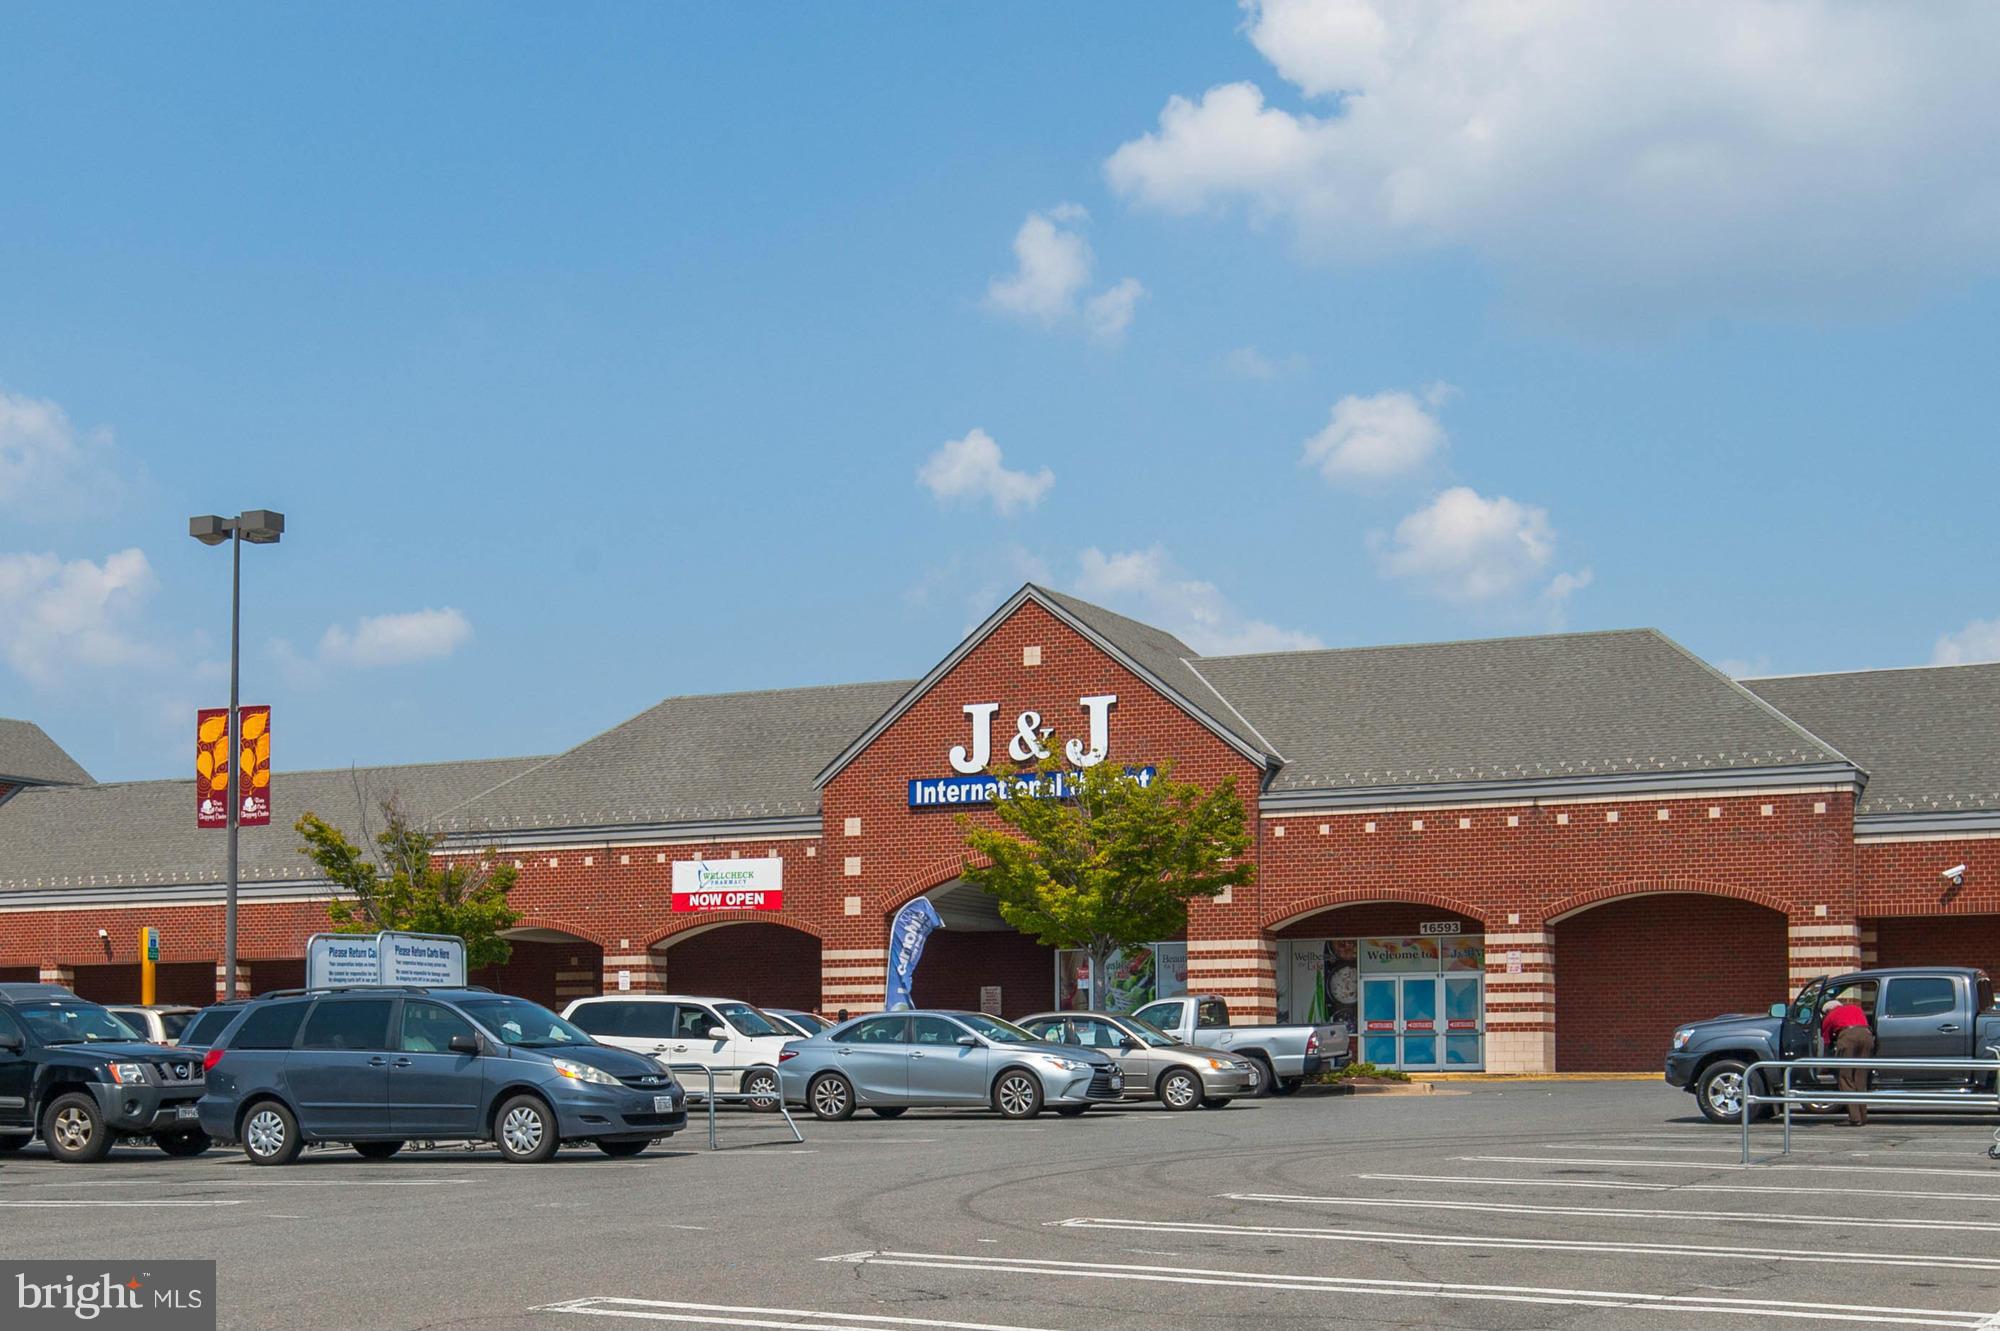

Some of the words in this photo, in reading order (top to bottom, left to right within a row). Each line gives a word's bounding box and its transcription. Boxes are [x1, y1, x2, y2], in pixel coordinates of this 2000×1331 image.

[949, 702, 999, 773] J
[1008, 711, 1054, 761] &
[1065, 695, 1116, 767] J
[916, 773, 1062, 803] Internatonl
[703, 871, 754, 880] WELLCHECK
[690, 894, 722, 906] NOW
[726, 893, 764, 905] OPEN
[1422, 923, 1460, 933] 16593
[329, 947, 347, 958] Please
[348, 948, 366, 958] Return
[368, 948, 377, 958] Ca
[395, 945, 410, 956] Please
[411, 946, 426, 957] Return
[427, 947, 438, 958] Carts
[439, 948, 449, 959] Here
[1368, 951, 1420, 960] Welcome
